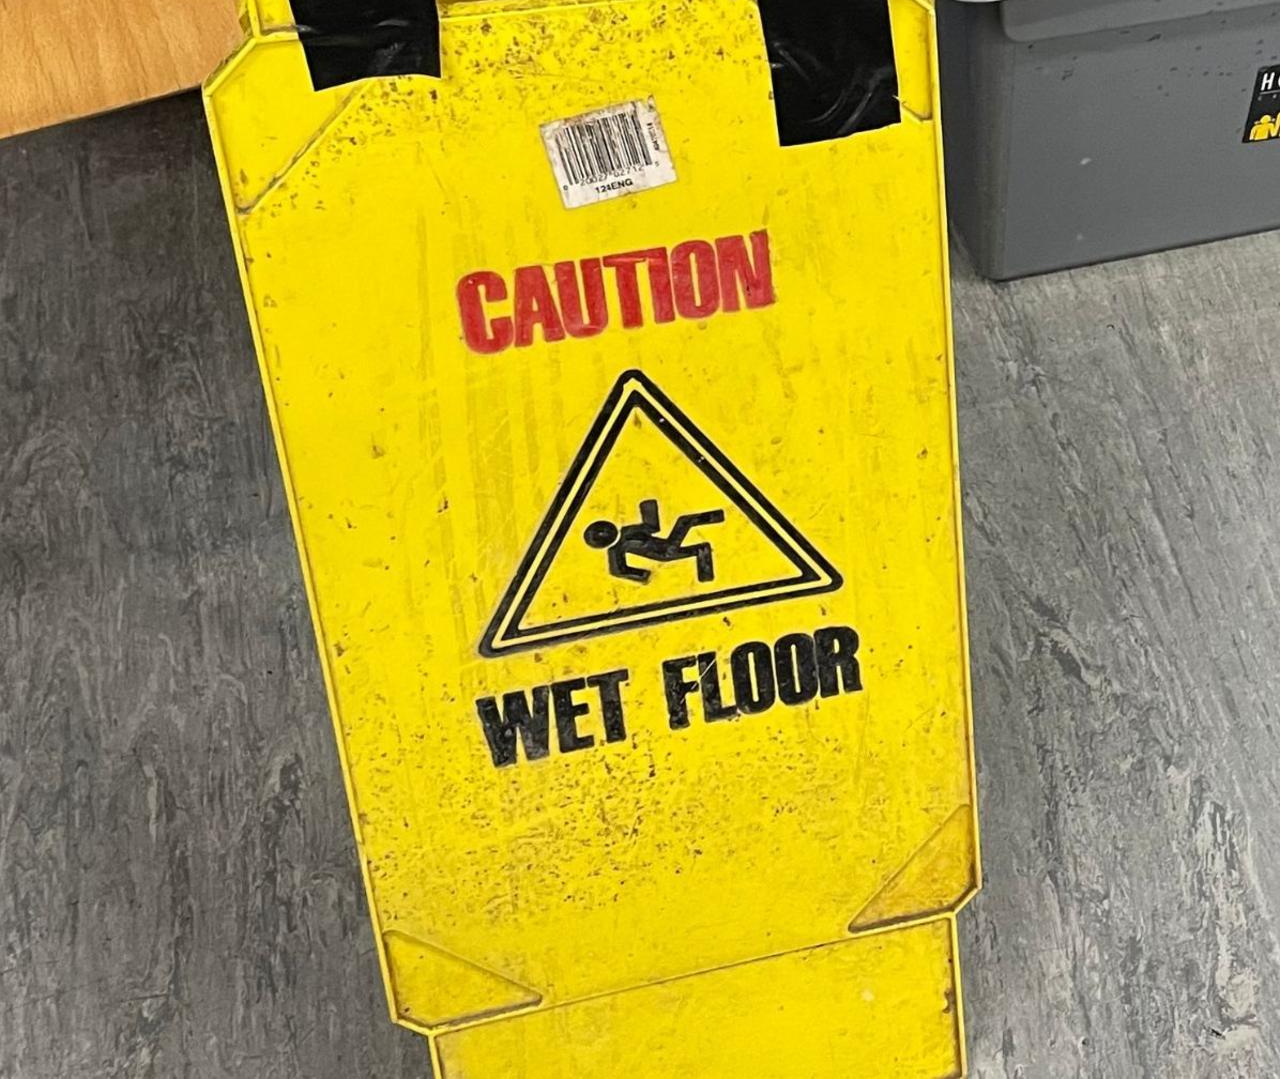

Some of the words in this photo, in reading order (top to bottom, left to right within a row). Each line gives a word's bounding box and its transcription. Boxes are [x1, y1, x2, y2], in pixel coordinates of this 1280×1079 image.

[456, 228, 777, 355] CAUTION
[475, 669, 632, 768] WET
[662, 624, 863, 730] FLOOR
